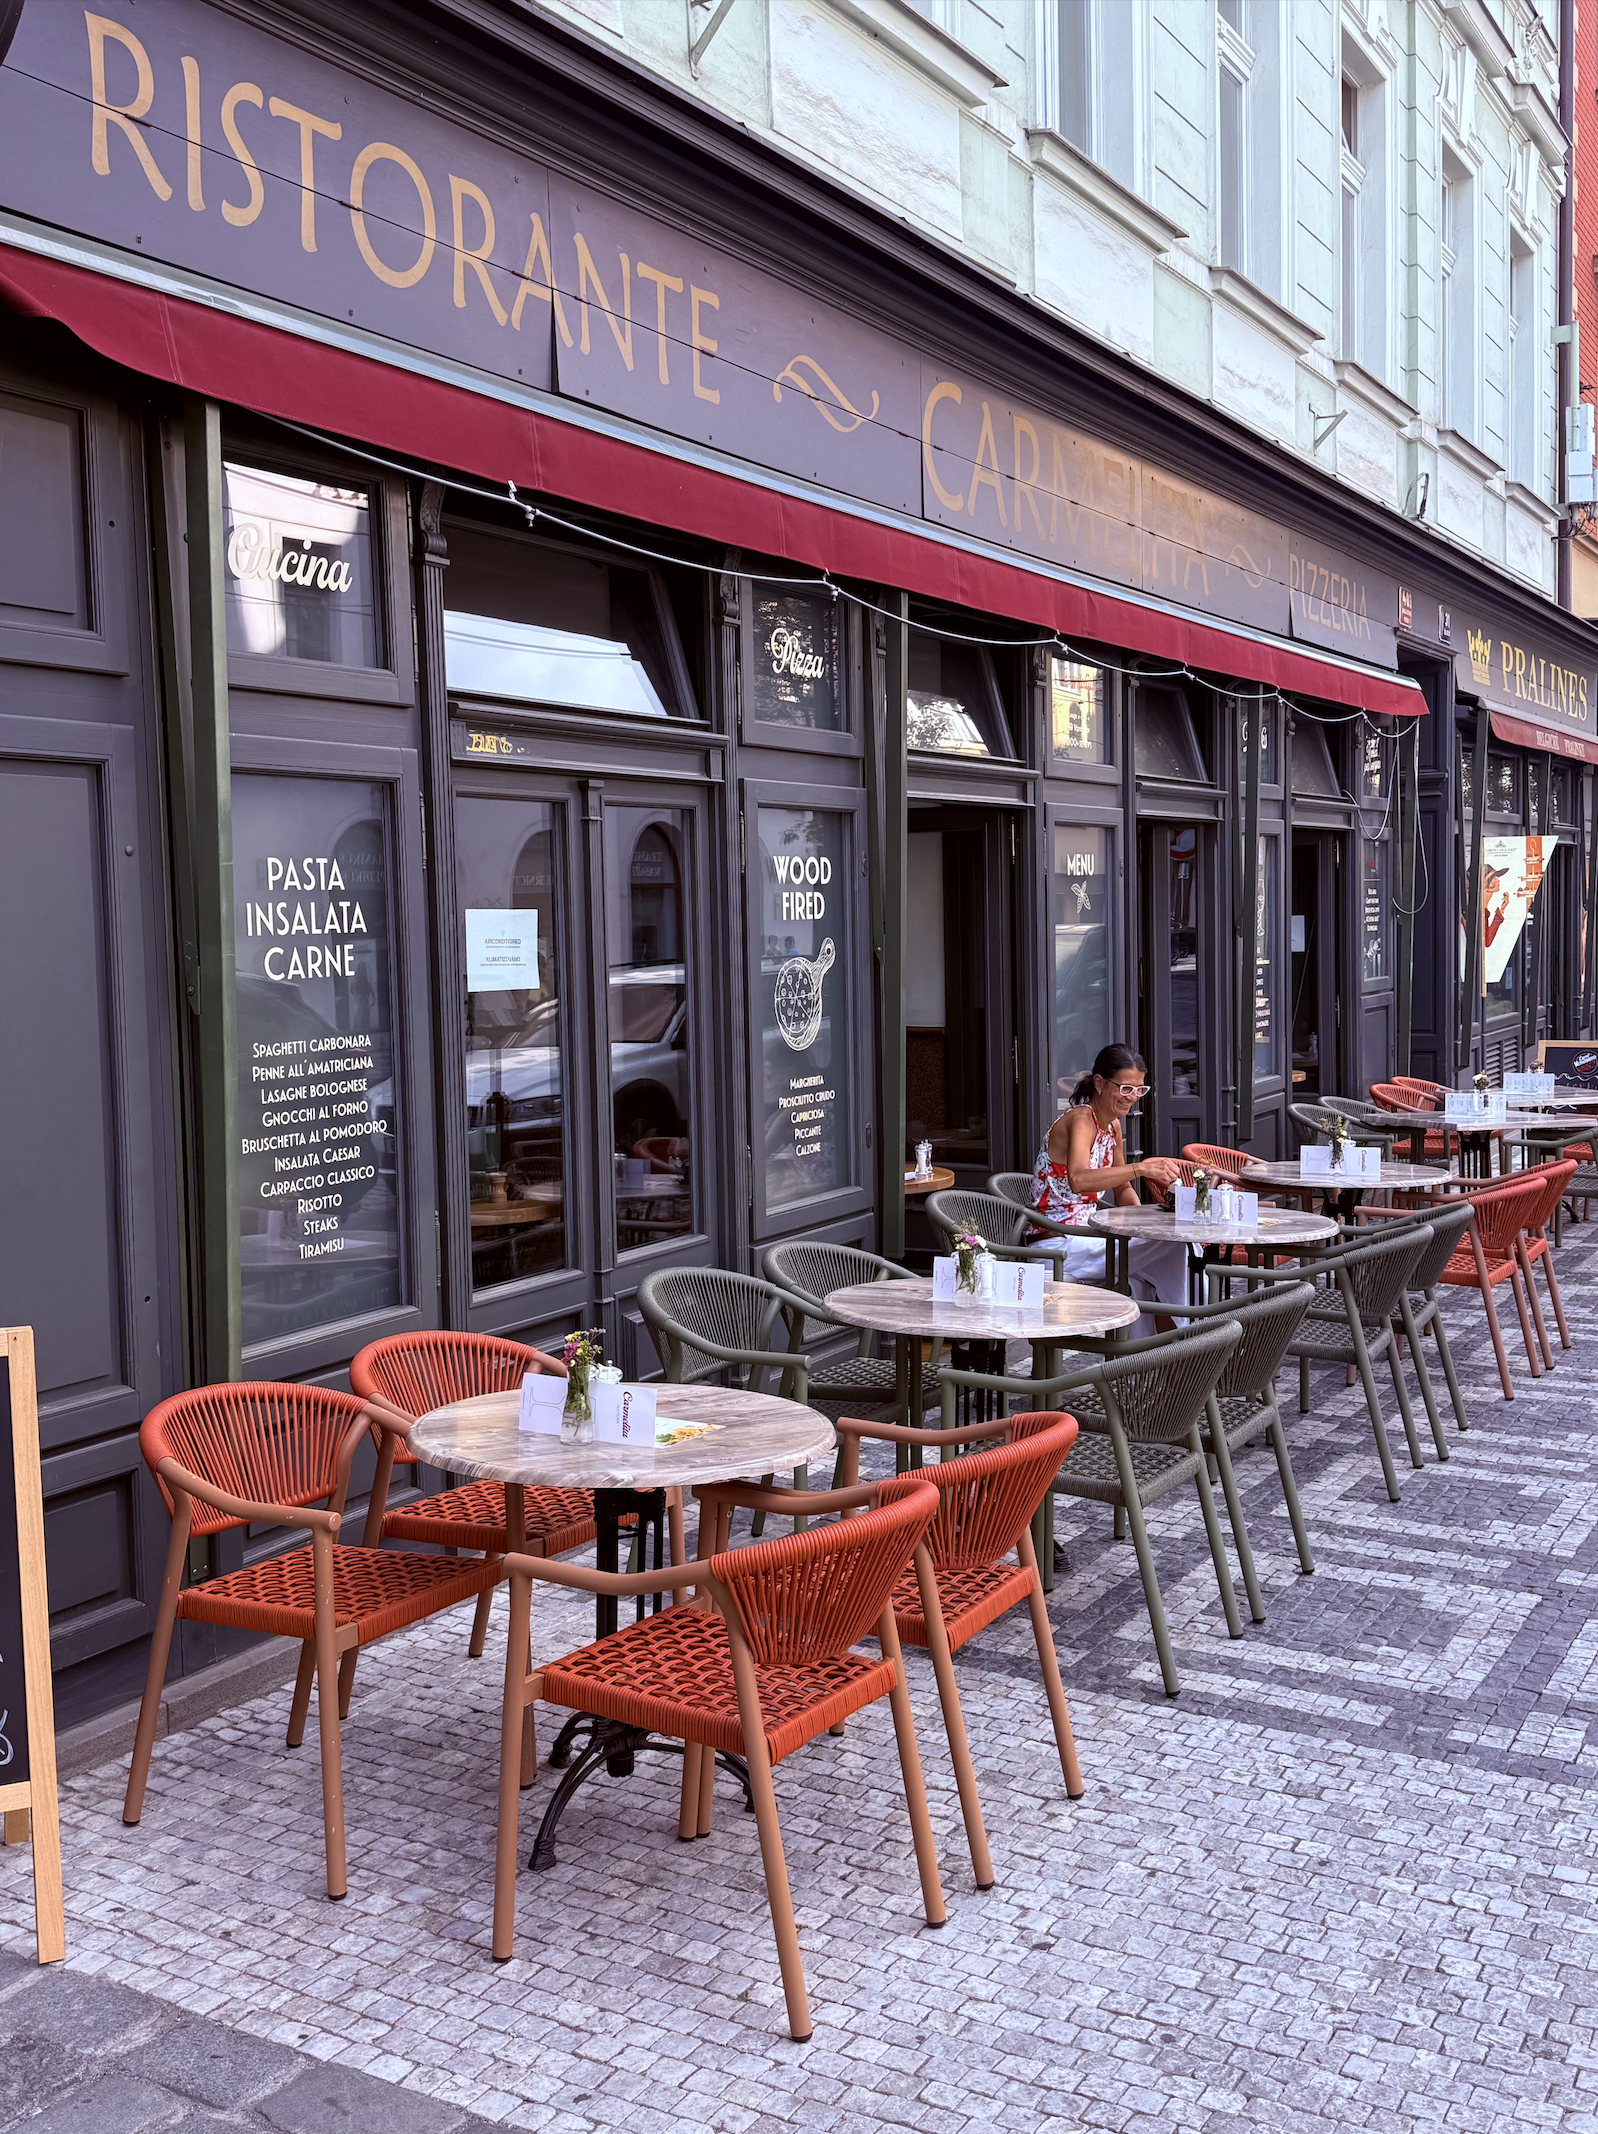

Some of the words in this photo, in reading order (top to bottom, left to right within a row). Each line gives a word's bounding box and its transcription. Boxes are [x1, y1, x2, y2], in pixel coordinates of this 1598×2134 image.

[84, 10, 721, 404] RISTORANTE
[922, 381, 1209, 597] CARMELITA
[228, 523, 353, 593] Cucina
[1289, 553, 1371, 641] PIZZERIA
[771, 627, 825, 679] Pizza
[1501, 641, 1588, 722] PRALINES
[267, 857, 345, 890] PASTA
[773, 855, 832, 885] WOOD
[1067, 854, 1095, 876] MENU
[246, 902, 367, 936] INSALATA
[783, 892, 824, 920] FIRED
[264, 944, 355, 980] CARNE
[253, 1041, 306, 1058] SPAGHETTI
[310, 1035, 371, 1052] CARBONARA
[253, 1066, 285, 1082] PENNE
[790, 1075, 824, 1089] MARGHERITA
[262, 1086, 307, 1104] LASAGNE
[310, 1078, 367, 1097] BOLOGNESE
[779, 1094, 814, 1108] PROSCIUTTO
[815, 1090, 835, 1102] CRUDO
[263, 1108, 315, 1127] GNOCCHI
[319, 1106, 330, 1119] AL
[333, 1101, 368, 1117] FORNO
[242, 1134, 306, 1154] BRUSCHETTA
[309, 1130, 320, 1143] AL
[324, 1120, 388, 1141] POMODORO
[795, 1126, 821, 1139] PICCANTE
[275, 1154, 320, 1172] INSALATA
[323, 1146, 360, 1163] CAESAR
[796, 1142, 821, 1156] CALZONE
[261, 1177, 325, 1198] CARPACCIO
[328, 1166, 374, 1185] CLASSICO
[298, 1194, 342, 1214] RISOTTO
[304, 1217, 338, 1235] STEAKS
[299, 1238, 346, 1259] TIRAMISU
